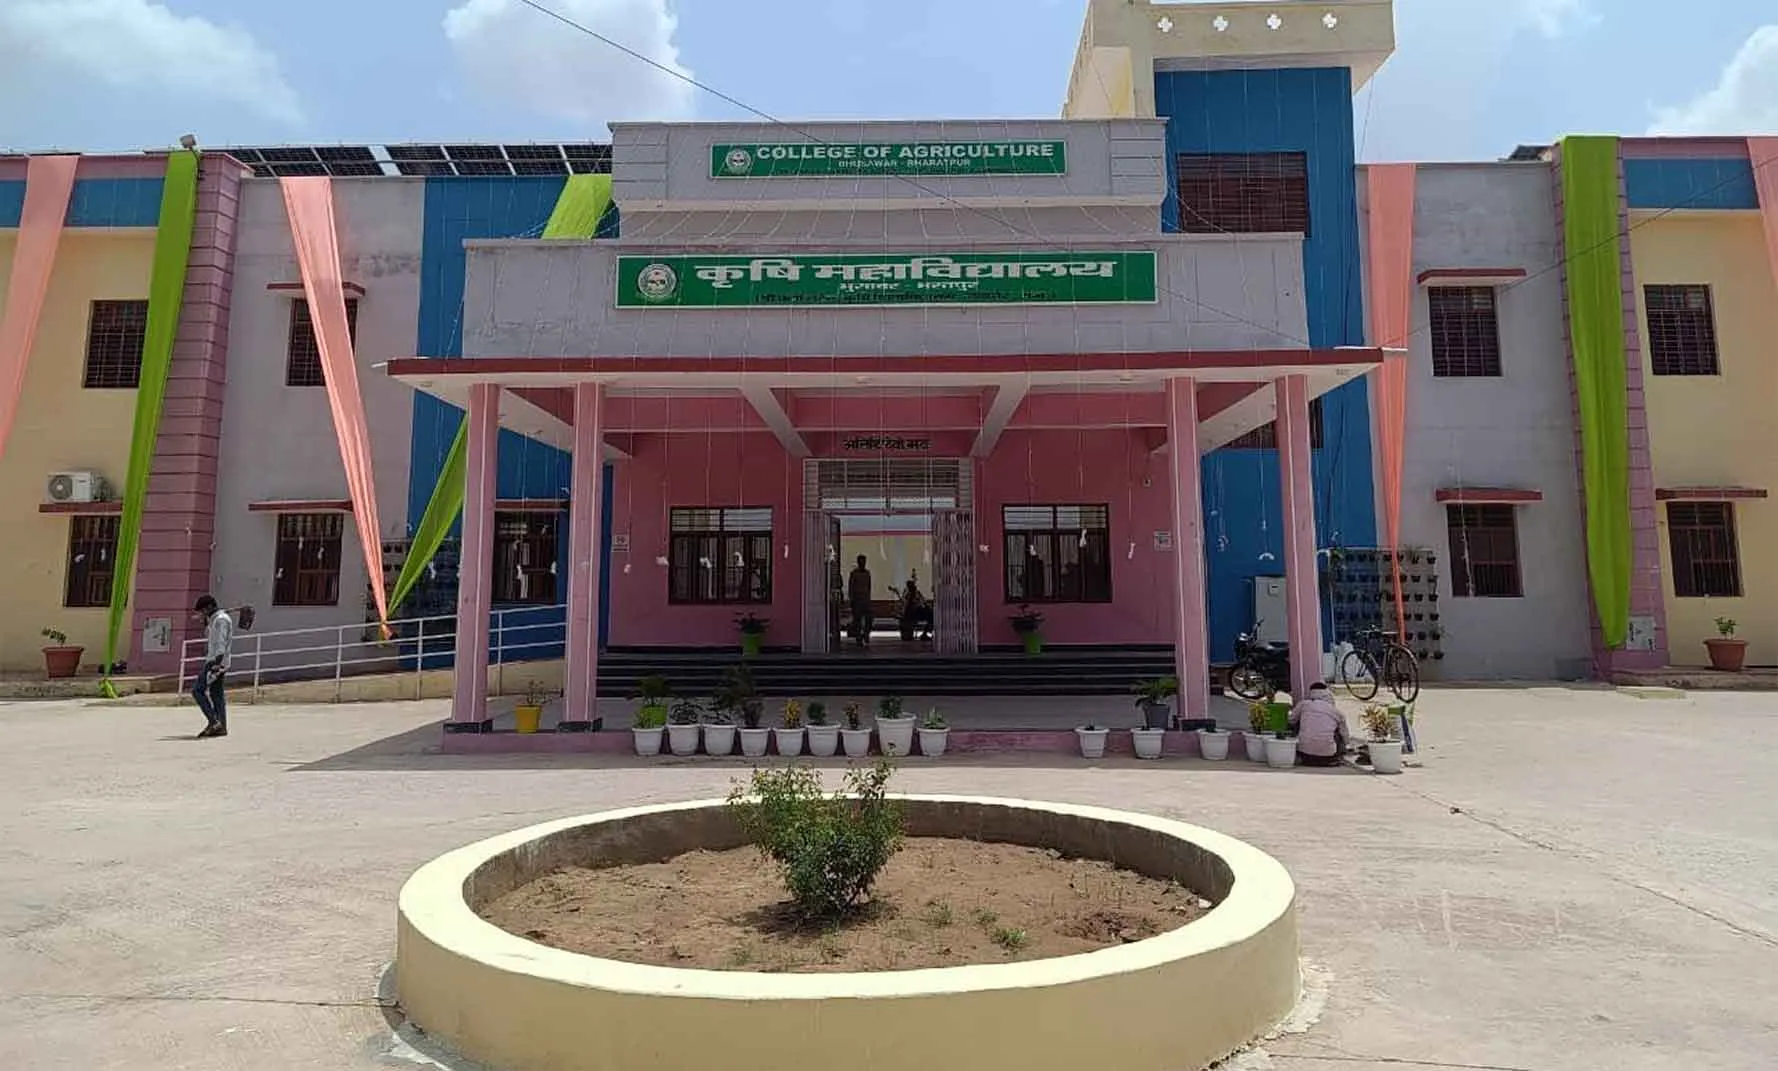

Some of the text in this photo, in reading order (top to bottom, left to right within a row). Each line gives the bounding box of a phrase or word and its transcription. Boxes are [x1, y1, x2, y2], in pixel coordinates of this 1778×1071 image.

[757, 144, 1055, 160] COLLEGE OF AGRICULTURE
[694, 257, 1118, 289] कृषि महाविद्यालय
